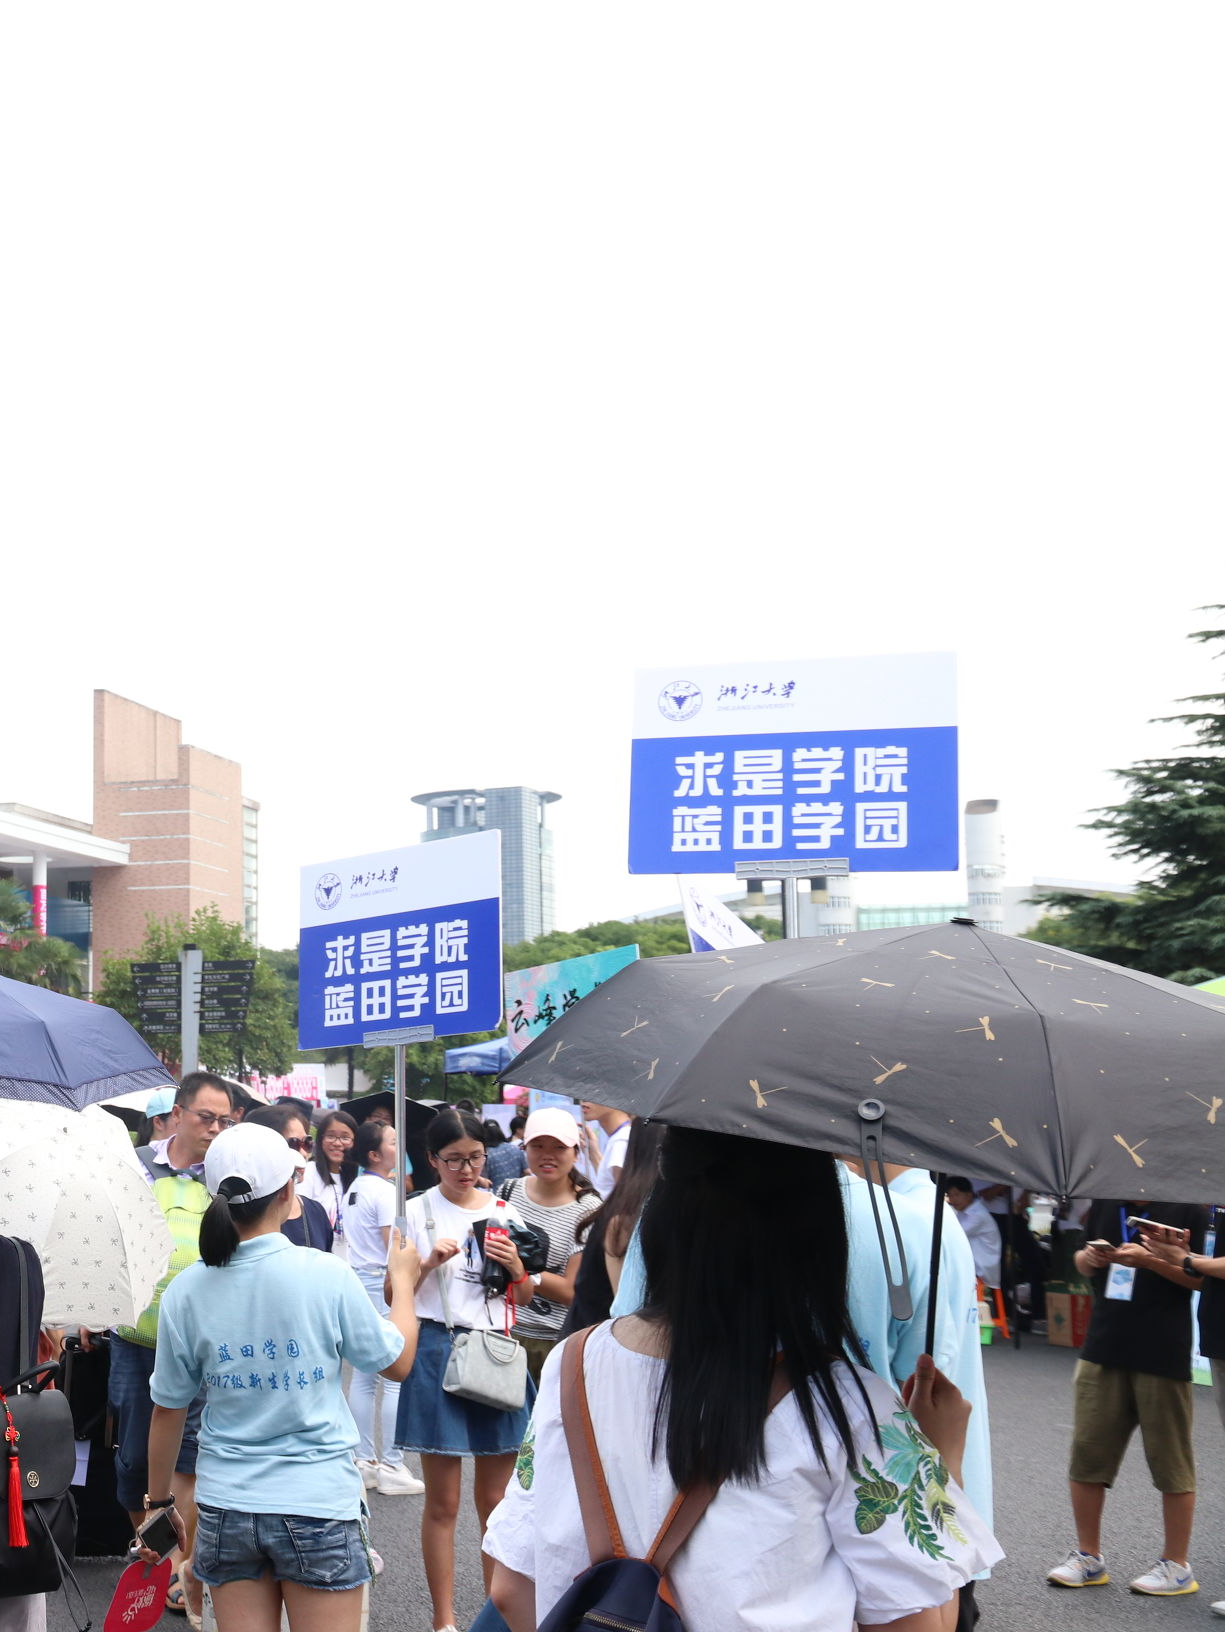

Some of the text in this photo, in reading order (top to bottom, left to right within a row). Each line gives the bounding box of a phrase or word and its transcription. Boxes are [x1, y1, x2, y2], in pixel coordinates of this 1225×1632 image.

[674, 745, 908, 797] 求是学院
[671, 801, 908, 852] 蓝田学园
[325, 919, 469, 978] 求是学院
[324, 969, 469, 1027] 蓝田学园
[512, 982, 602, 1034] 云峰学
[218, 1338, 300, 1363] 蓝田学园
